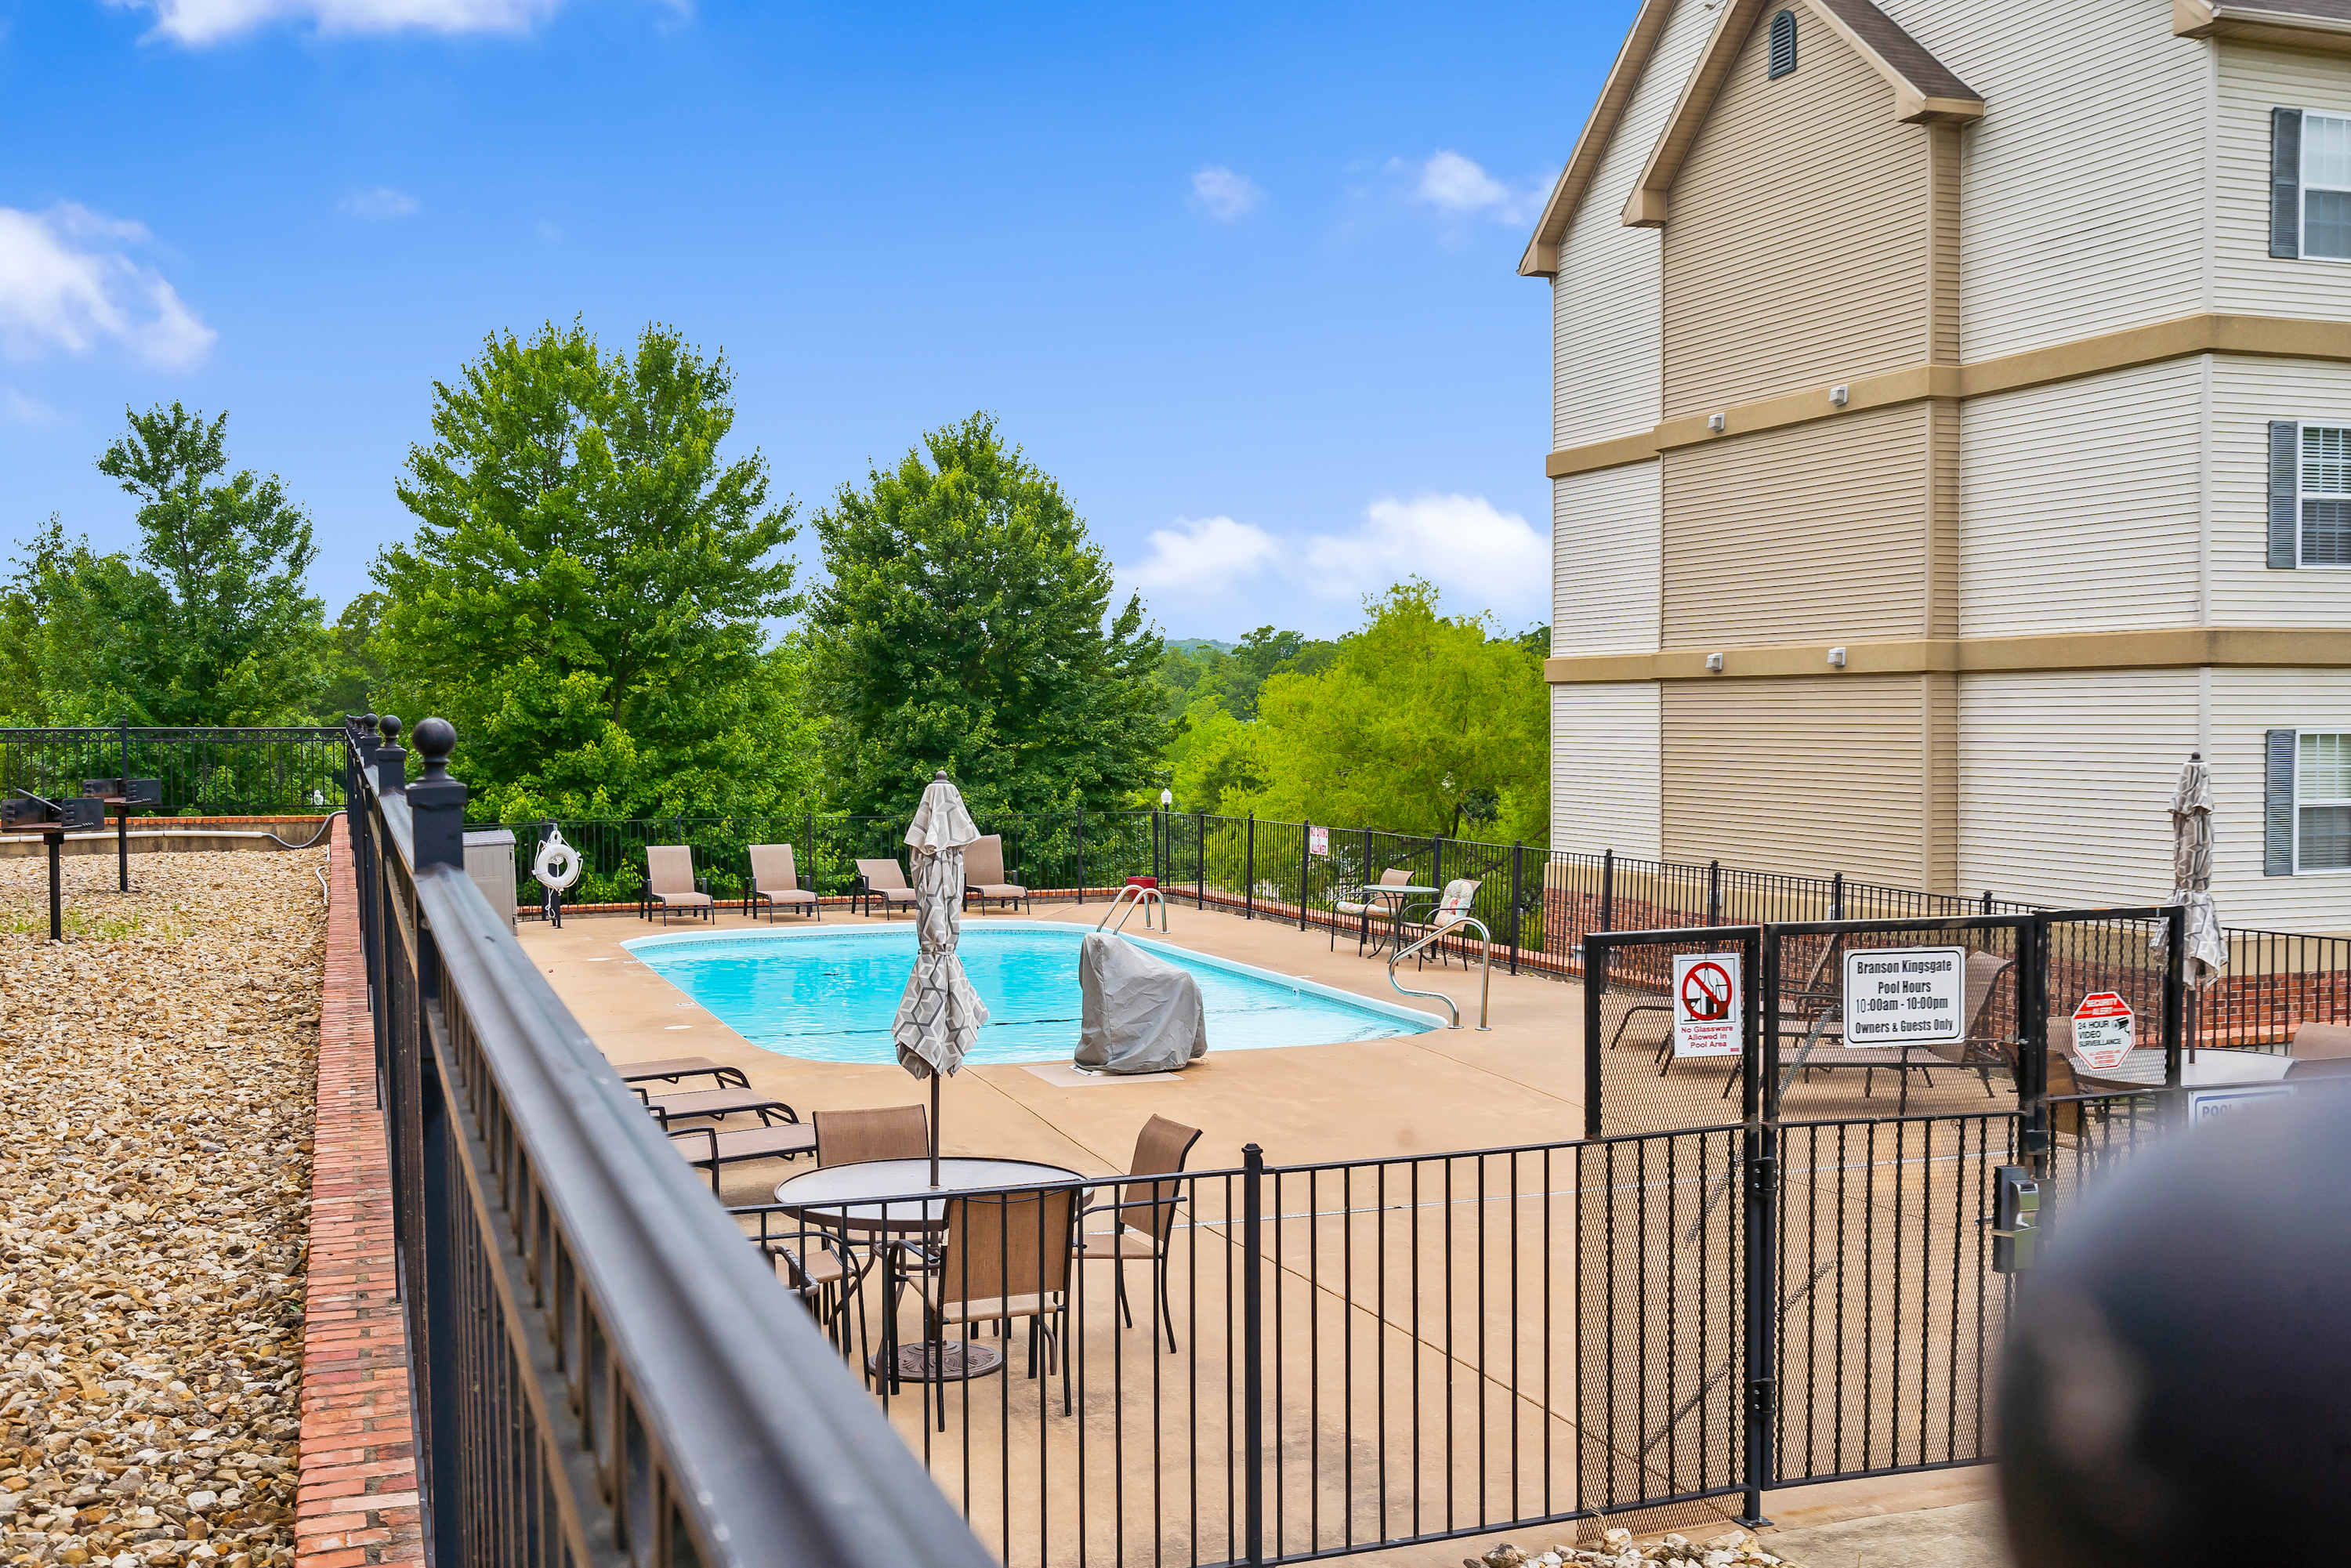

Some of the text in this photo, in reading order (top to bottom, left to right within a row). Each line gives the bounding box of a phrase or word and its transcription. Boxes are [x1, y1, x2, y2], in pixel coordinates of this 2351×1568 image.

[1857, 960, 1952, 975] Branson Kingsgate
[1878, 980, 1932, 994] Pool Hours
[1856, 998, 1898, 1013] 10:00am
[1907, 997, 1948, 1010] 10:00pm
[1856, 1019, 1953, 1034] Owners & Guests Only
[2088, 1020, 2110, 1029] HOUR
[2078, 1030, 2102, 1039] VIDEO
[2078, 1038, 2122, 1047] SURVEILLANCE
[2201, 1103, 2233, 1119] POO
